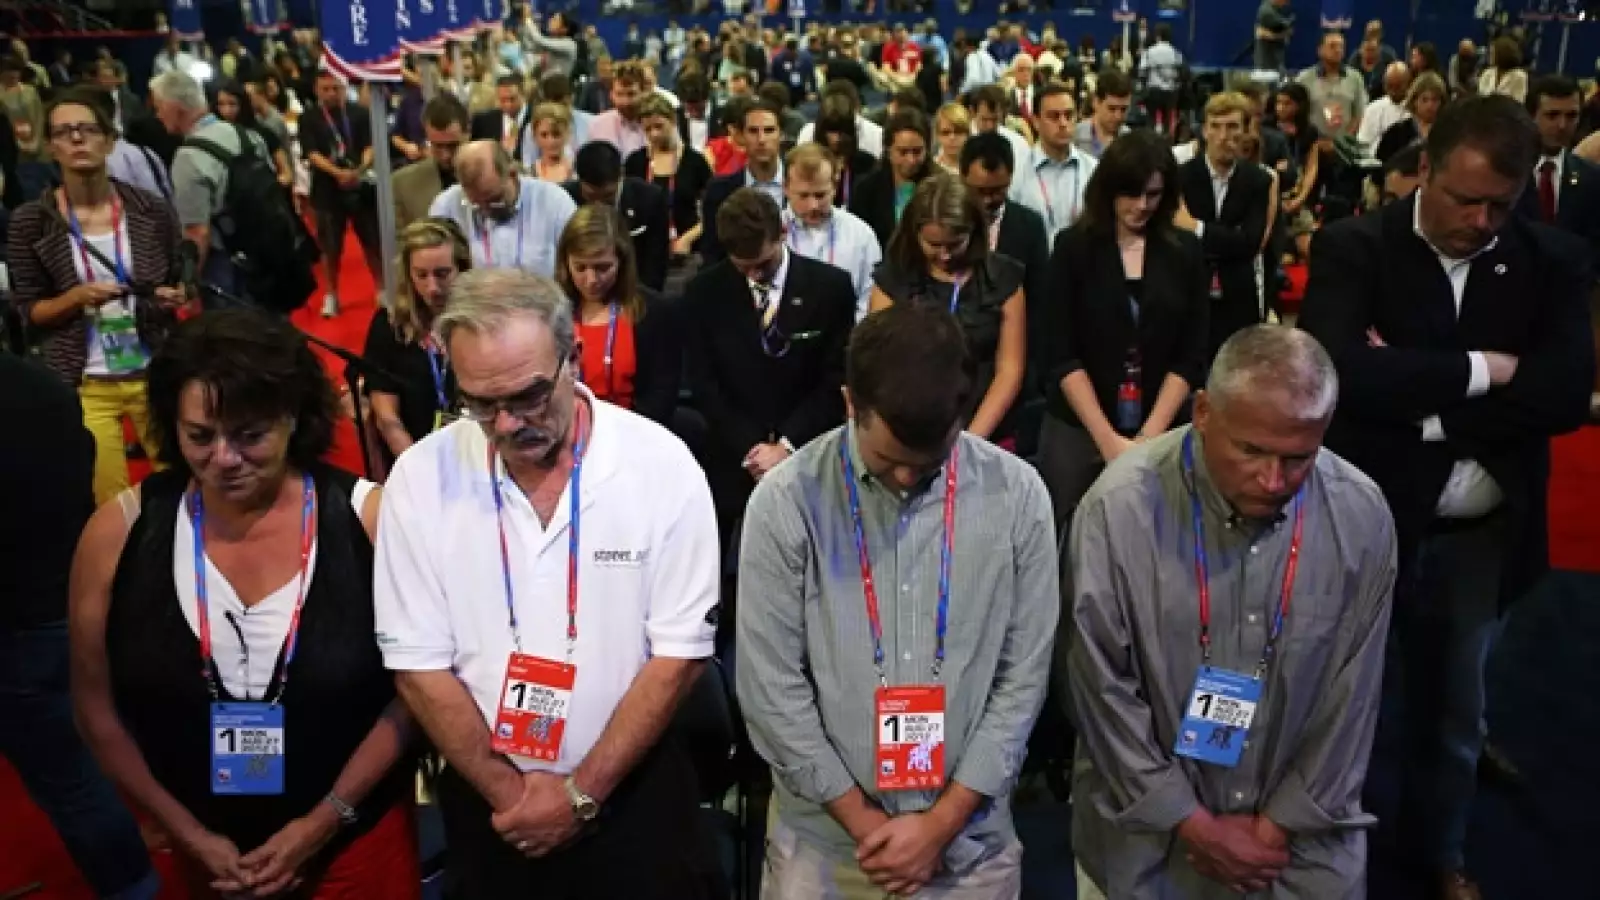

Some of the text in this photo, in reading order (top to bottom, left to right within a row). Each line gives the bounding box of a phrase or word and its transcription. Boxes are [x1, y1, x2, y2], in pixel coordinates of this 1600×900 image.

[510, 683, 526, 709] 1
[1197, 694, 1212, 717] 1
[219, 728, 236, 752] 1
[884, 714, 899, 742] 1
